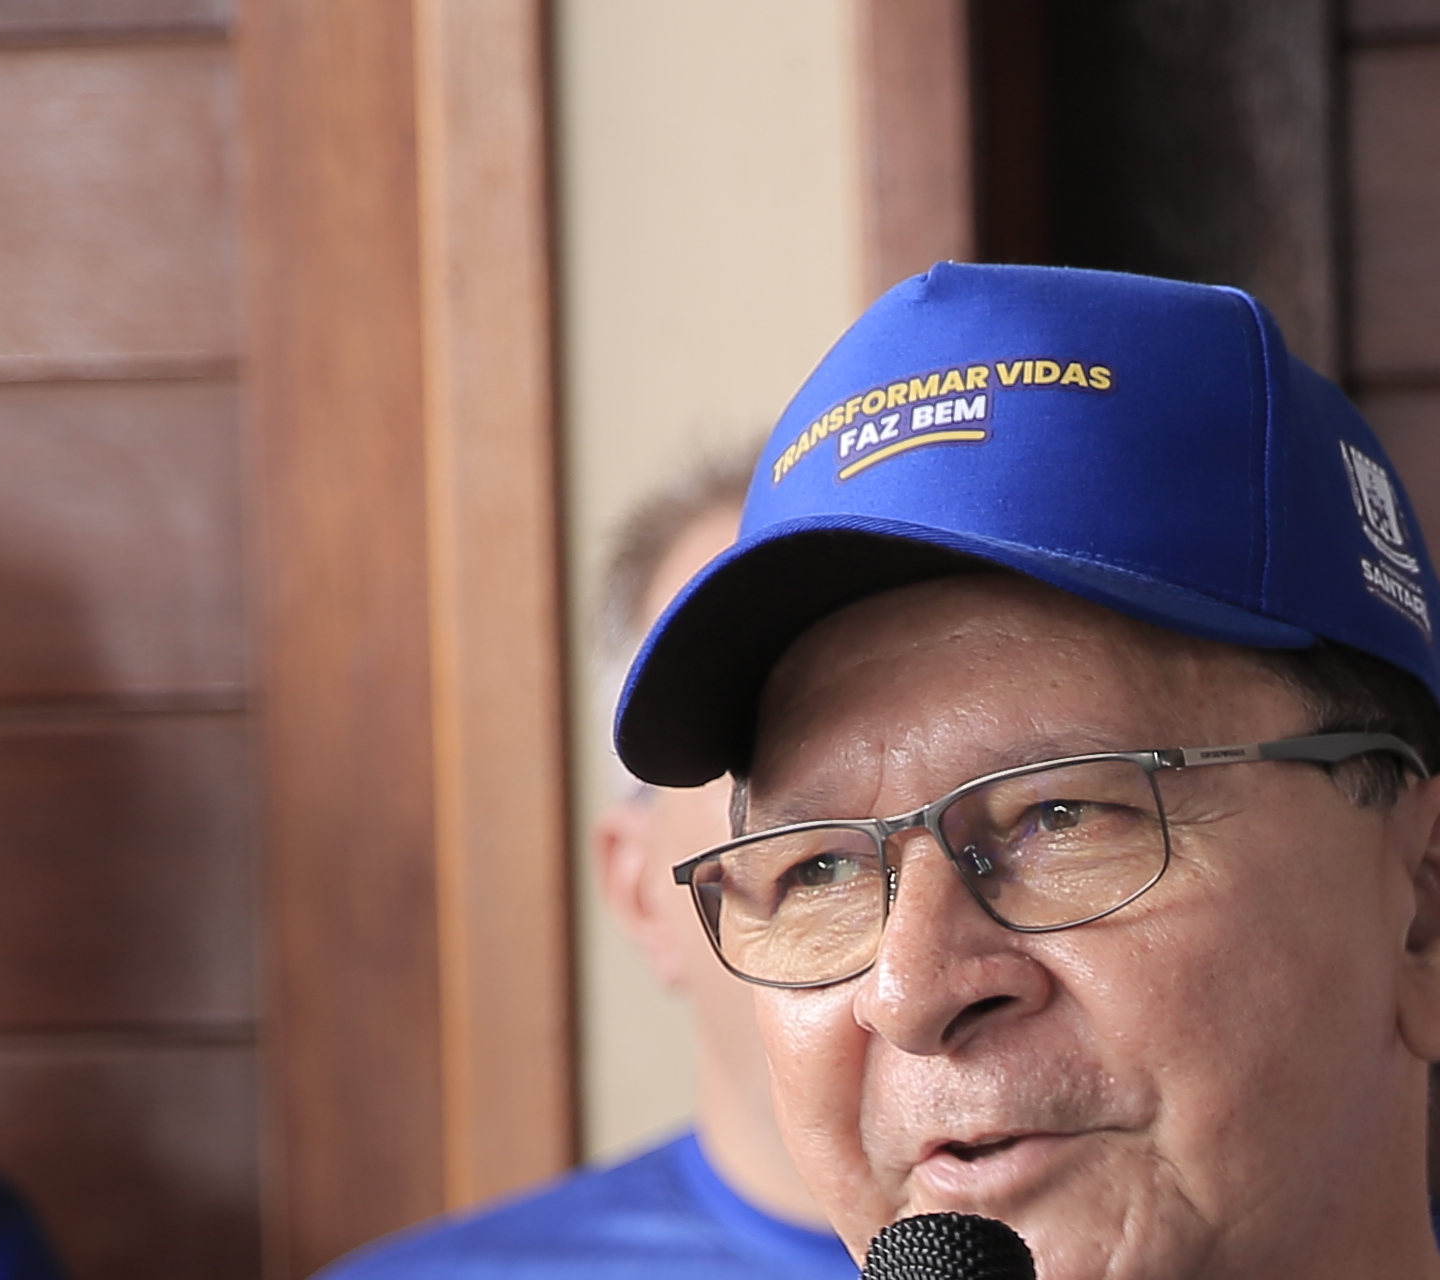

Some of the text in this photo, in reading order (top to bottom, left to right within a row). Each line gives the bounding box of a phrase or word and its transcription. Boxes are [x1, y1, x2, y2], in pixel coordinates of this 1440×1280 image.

[772, 360, 1112, 483] TRANSFORMAR VIDAS
[838, 395, 987, 458] FAZ BEM
